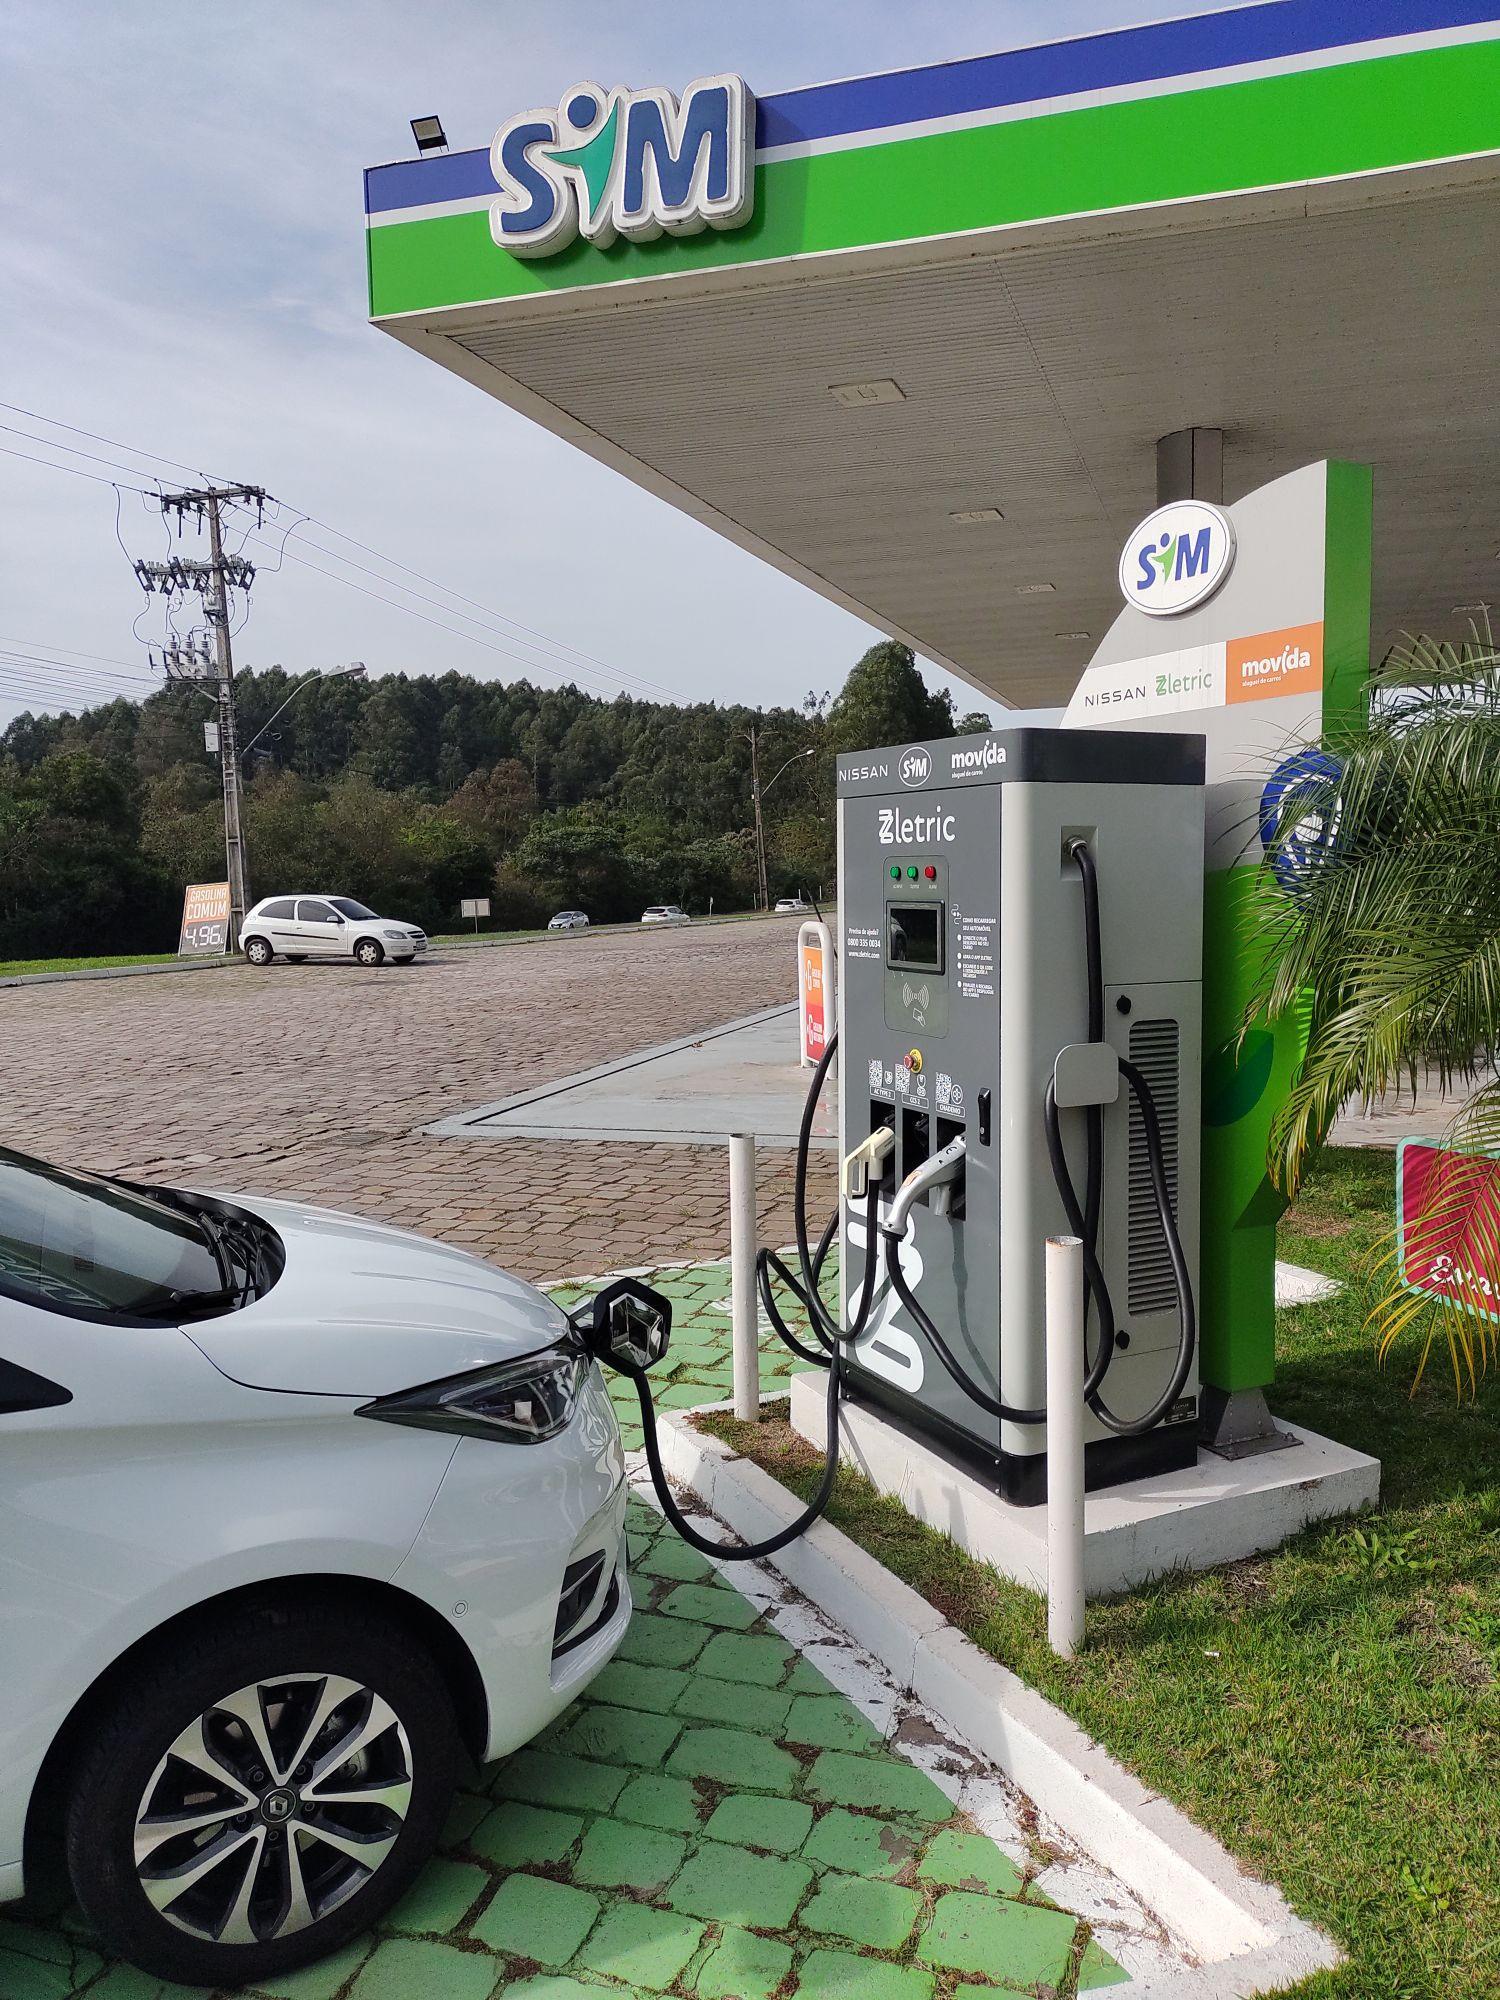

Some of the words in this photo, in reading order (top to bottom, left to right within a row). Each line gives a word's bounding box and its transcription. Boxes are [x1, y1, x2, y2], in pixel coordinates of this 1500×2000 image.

[498, 83, 732, 236] SIM
[1137, 526, 1212, 591] SIM
[1241, 644, 1311, 678] movida
[1084, 685, 1147, 707] NISSAN
[1155, 668, 1213, 697] Zletric
[838, 764, 889, 781] NISSAN
[903, 756, 928, 779] SIM
[951, 739, 1007, 769] movida
[878, 805, 956, 844] Zletric
[186, 901, 227, 920] COMUM
[190, 888, 227, 902] GASOLINA
[847, 937, 859, 947] 0800
[868, 939, 881, 948] 0034
